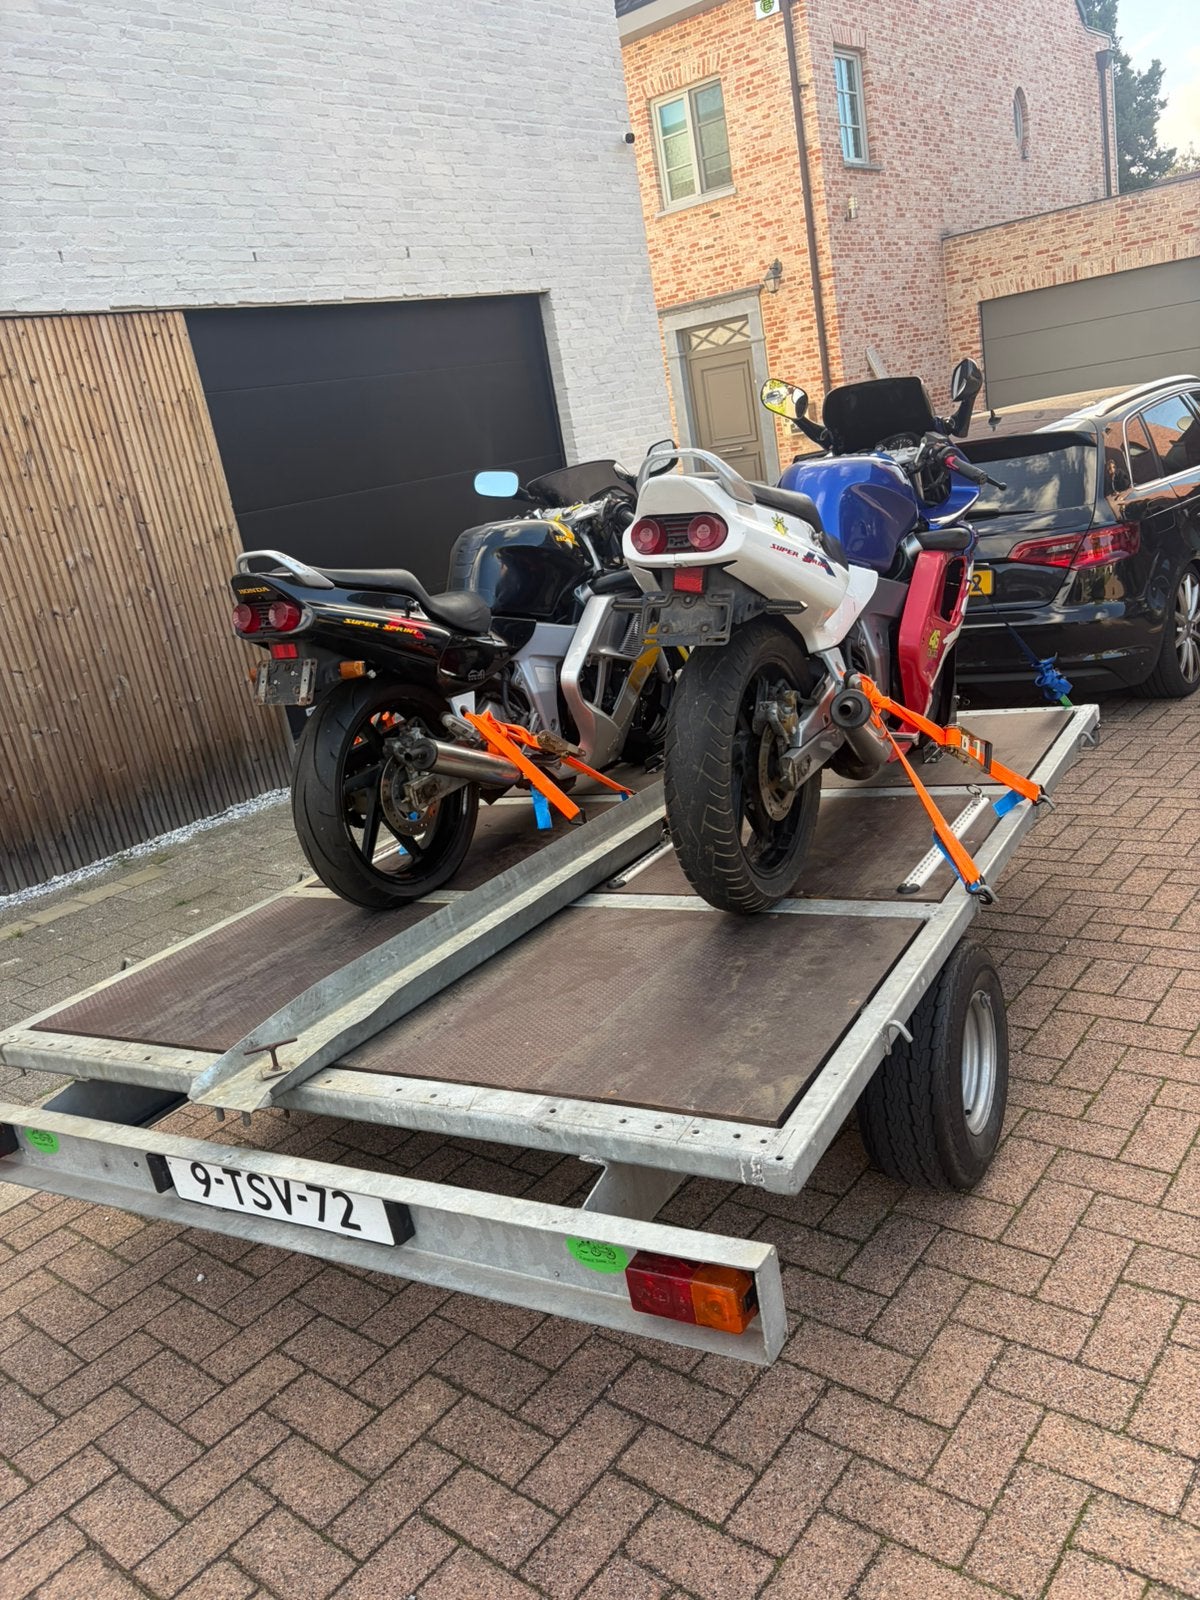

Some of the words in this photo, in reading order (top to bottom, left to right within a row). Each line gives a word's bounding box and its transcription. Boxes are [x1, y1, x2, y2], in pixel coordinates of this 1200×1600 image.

[770, 543, 799, 557] SUPER
[237, 586, 270, 595] HONDA
[343, 618, 379, 628] SUPER
[382, 624, 418, 635] SPRINT
[190, 1162, 362, 1231] 9-TSV-72
